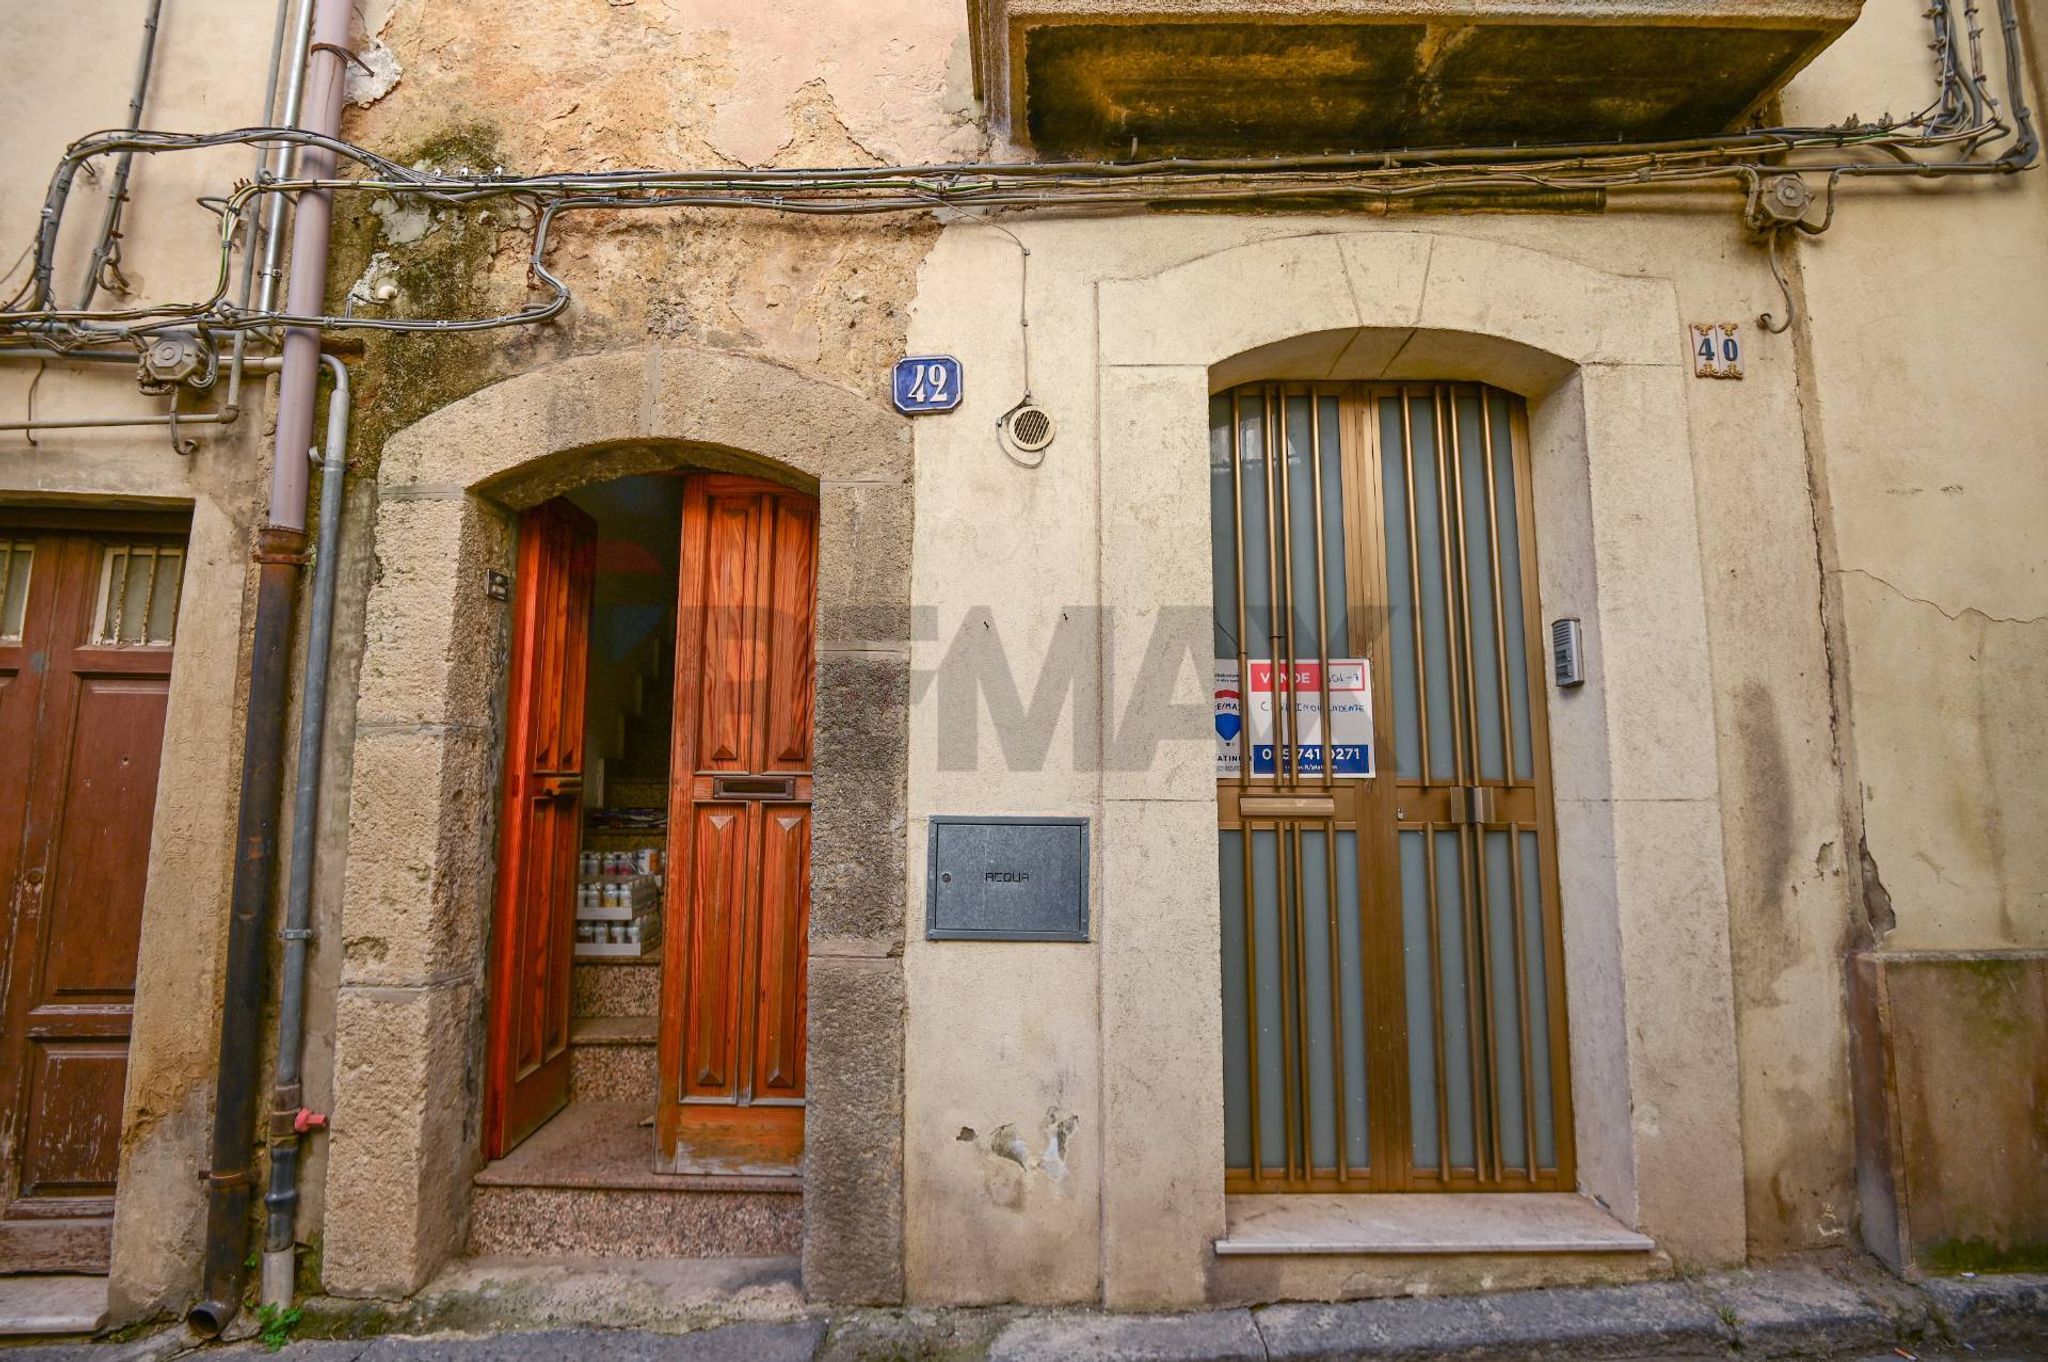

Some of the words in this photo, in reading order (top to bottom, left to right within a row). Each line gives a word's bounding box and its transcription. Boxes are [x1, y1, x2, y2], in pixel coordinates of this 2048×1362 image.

[1698, 337, 1738, 361] 40
[907, 364, 948, 402] 42
[1260, 672, 1310, 684] VNDE
[1215, 702, 1241, 711] E/MA
[1262, 748, 1290, 760] 05
[985, 872, 1030, 882] ACQUA
